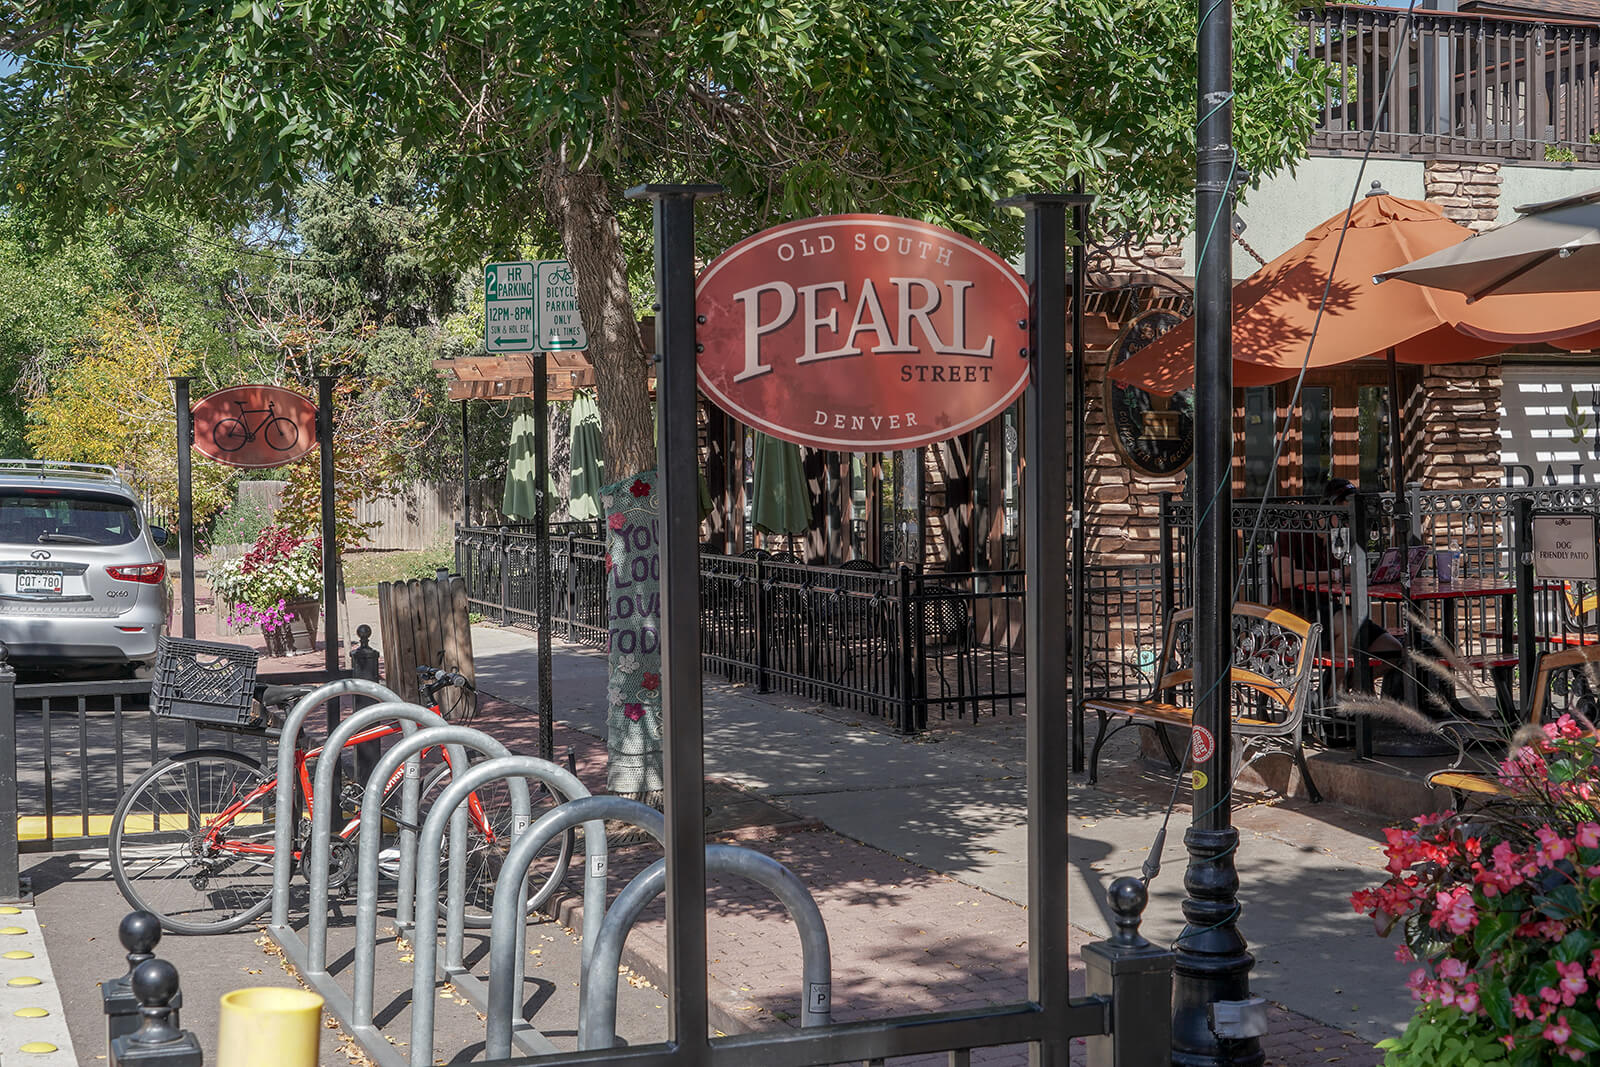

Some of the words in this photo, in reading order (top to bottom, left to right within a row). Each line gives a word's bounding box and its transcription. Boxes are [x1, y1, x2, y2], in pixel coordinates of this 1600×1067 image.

[777, 235, 836, 262] OLD
[854, 233, 953, 267] SOUTH
[507, 267, 522, 281] HR
[487, 271, 496, 295] 2
[498, 282, 532, 297] PARKING
[546, 286, 577, 298] BICYCL
[553, 314, 572, 325] ONLY
[490, 325, 500, 335] SUN
[502, 325, 507, 334] &
[508, 325, 518, 334] HOL
[520, 324, 529, 334] EXC
[549, 327, 560, 337] ALL
[563, 326, 580, 336] TIMES
[733, 277, 994, 383] PEARL
[900, 365, 993, 383] STREET
[813, 410, 918, 431] DENVER
[1555, 541, 1572, 549] DOG
[1540, 551, 1569, 559] FRIENDLY
[1570, 551, 1589, 560] PATIO
[106, 590, 129, 598] QX60
[817, 993, 827, 1005] P
